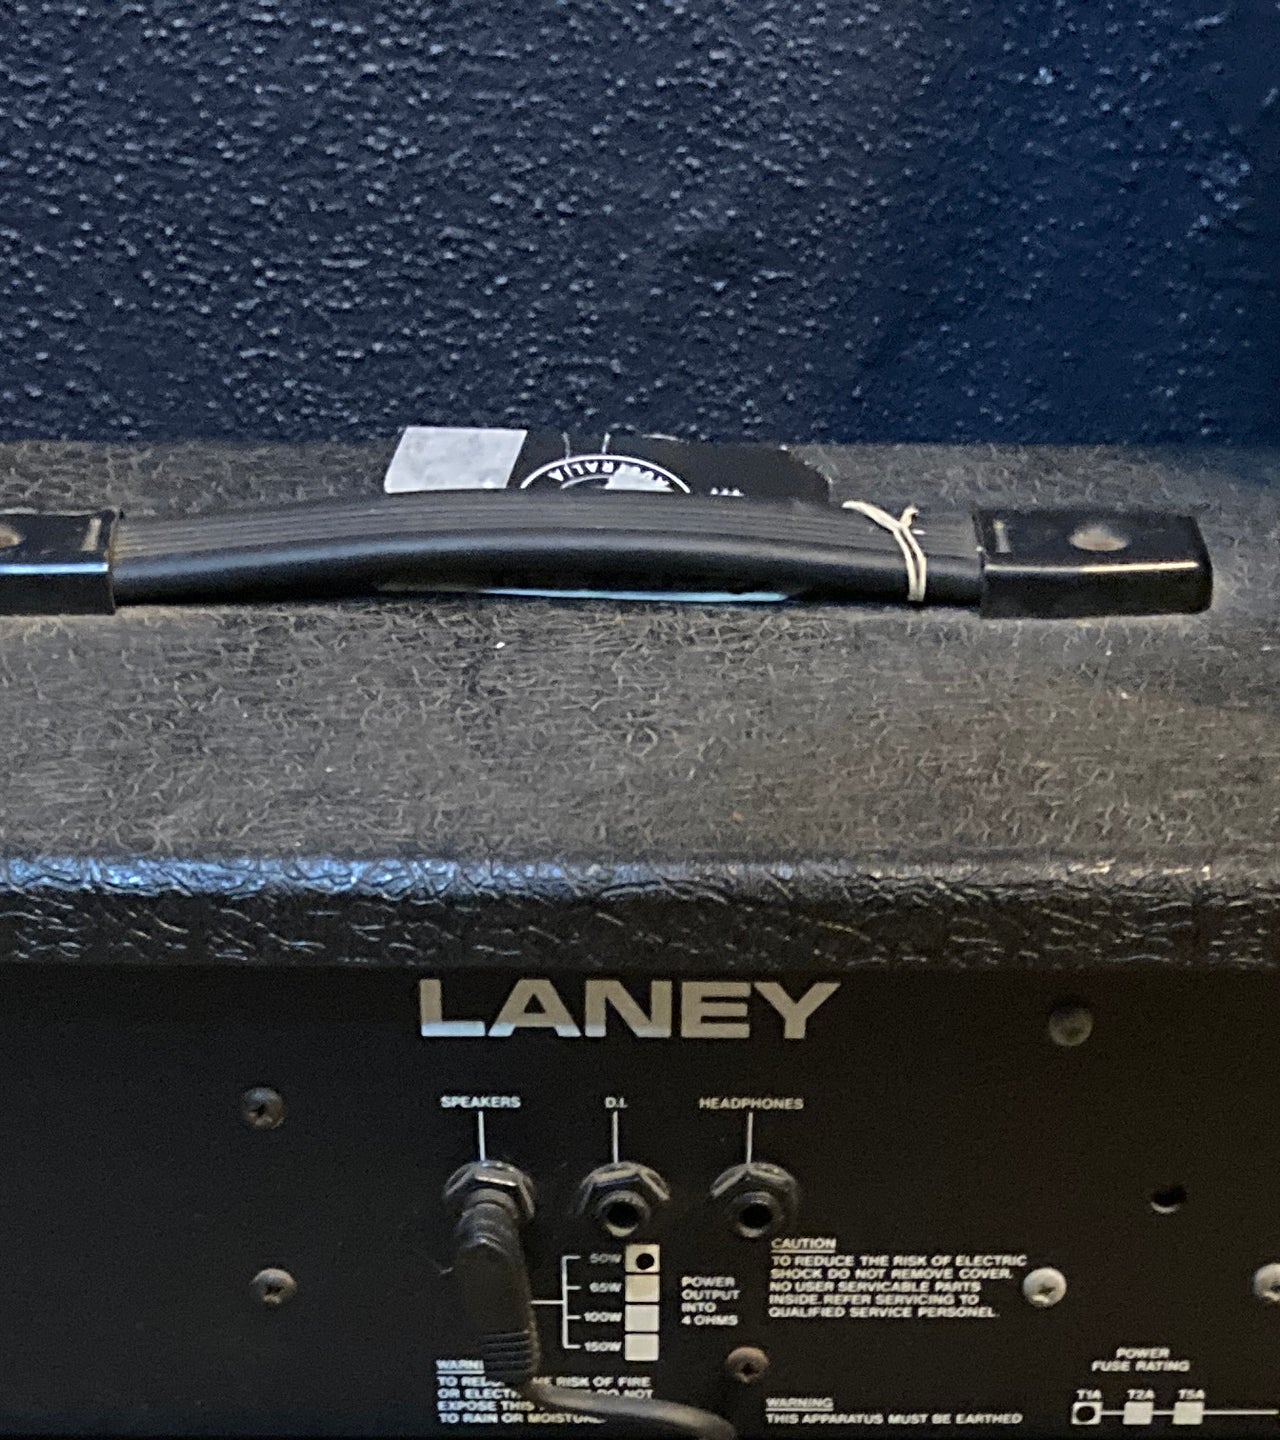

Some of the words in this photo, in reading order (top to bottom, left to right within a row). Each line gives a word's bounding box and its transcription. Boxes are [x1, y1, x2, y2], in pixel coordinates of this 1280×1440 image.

[420, 978, 842, 1039] LANEY
[440, 1095, 521, 1109] SPEAKERS
[699, 1098, 804, 1110] HEADPHONES
[771, 1237, 837, 1250] CAUTION
[772, 1255, 791, 1267] TO
[794, 1255, 854, 1267] REDUCE
[860, 1255, 889, 1267] THE
[893, 1255, 927, 1267] RISK
[931, 1255, 952, 1267] OF
[955, 1255, 1027, 1267] ELECTRIC
[771, 1268, 821, 1280] SHOCK
[827, 1268, 850, 1280] DO
[855, 1268, 886, 1280] NOT
[891, 1268, 953, 1280] REMOVE
[959, 1268, 1013, 1280] COVER.
[681, 1276, 735, 1288] POWER
[769, 1281, 792, 1292] NO
[795, 1281, 834, 1292] USER
[838, 1281, 929, 1293] SERVICABLE
[934, 1281, 981, 1293] PARTS
[681, 1289, 741, 1301] OUTPUT
[824, 1294, 871, 1306] REFER
[875, 1294, 955, 1306] SERVICING
[959, 1294, 979, 1306] TO
[681, 1302, 716, 1313] INTO
[768, 1307, 846, 1318] QUALIFIED
[850, 1307, 912, 1318] SERVICE
[584, 1311, 622, 1322] 100W
[681, 1315, 691, 1325] 4
[693, 1314, 738, 1326] OHMS
[584, 1341, 622, 1352] 150W
[1116, 1348, 1170, 1359] POWER
[436, 1360, 484, 1370] WARNI
[1091, 1361, 1131, 1371] FUSE
[1135, 1361, 1190, 1372] RATING
[438, 1377, 457, 1387] TO
[462, 1377, 504, 1387] RED
[556, 1376, 590, 1387] RISK
[593, 1376, 614, 1387] OF
[618, 1376, 651, 1387] FIRE
[438, 1389, 459, 1399] OR
[623, 1389, 654, 1398] NOT
[1076, 1389, 1101, 1400] T1A
[438, 1401, 496, 1411] EXPOSE
[501, 1401, 534, 1411] THIS
[766, 1398, 834, 1408] WARNING
[440, 1413, 458, 1423] TO
[463, 1413, 498, 1423] RAIN
[501, 1413, 523, 1423] OR
[767, 1413, 799, 1424] THIS
[802, 1413, 883, 1424] APPARATUS
[888, 1413, 928, 1424] MUST
[932, 1413, 952, 1424] BE
[955, 1413, 1023, 1424] EARTHED
